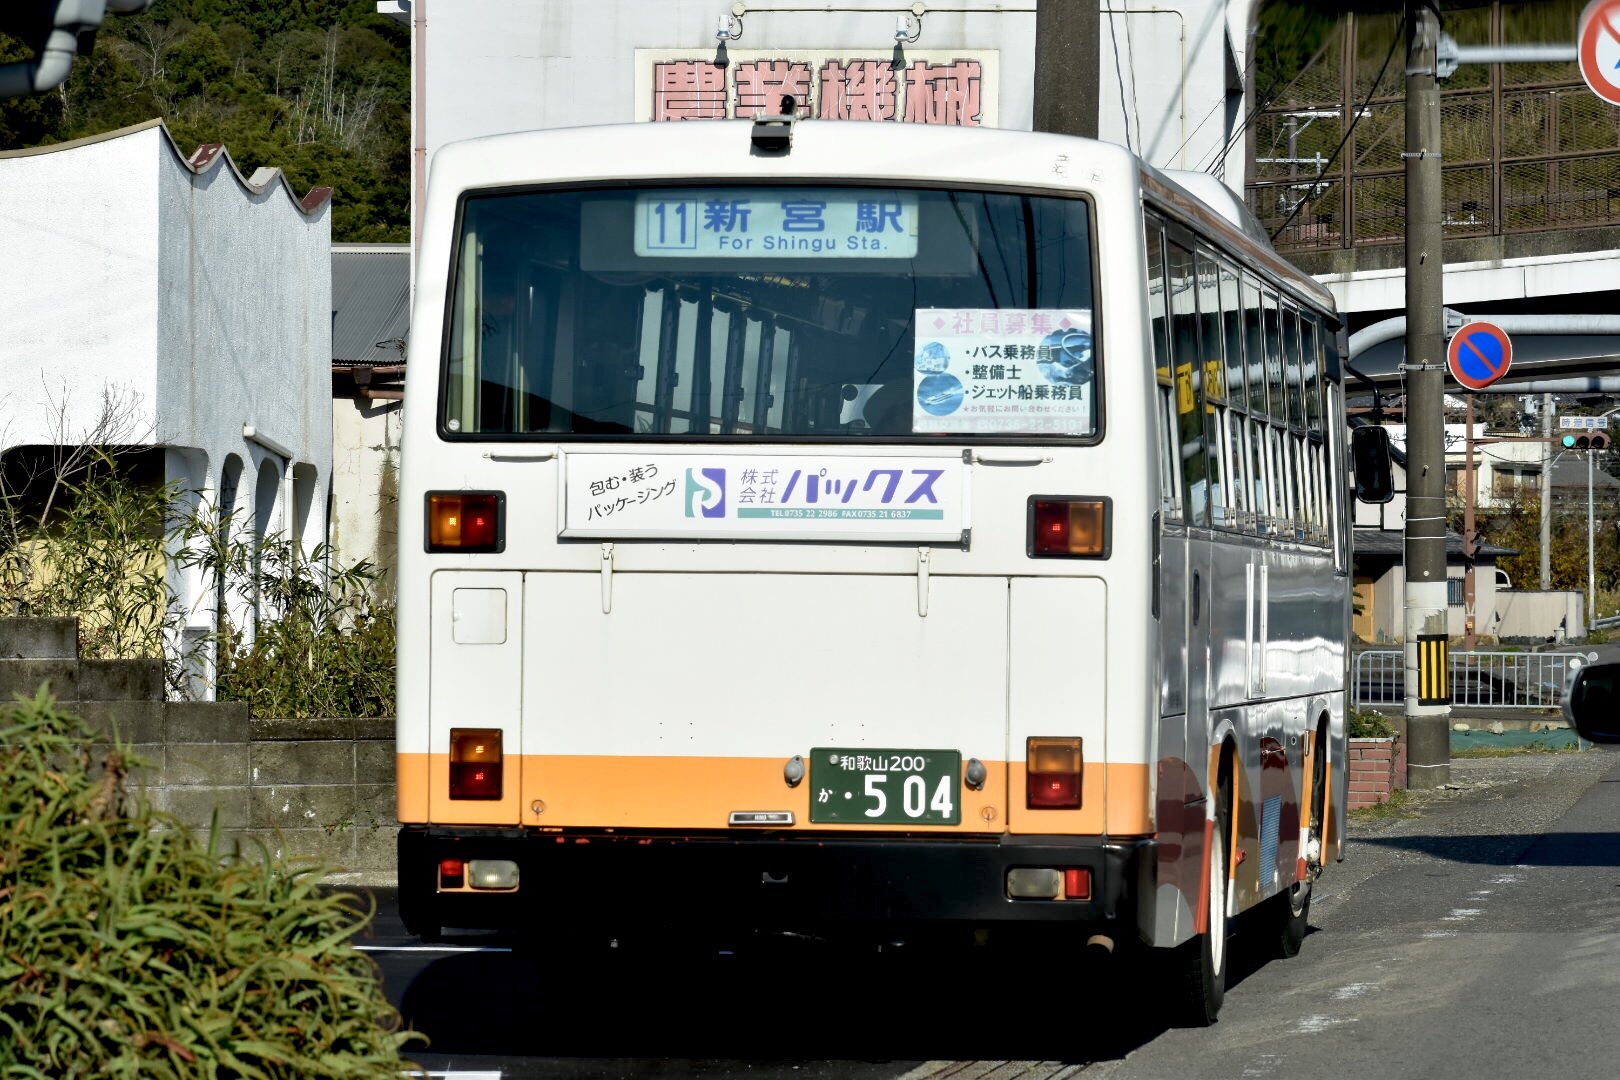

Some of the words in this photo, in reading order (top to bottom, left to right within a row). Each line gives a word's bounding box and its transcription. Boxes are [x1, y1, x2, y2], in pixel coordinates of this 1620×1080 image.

[655, 201, 687, 244] 11
[704, 199, 904, 233] 新宮駅
[719, 236, 753, 250] For
[763, 235, 836, 252] Shingu
[847, 236, 888, 250] Sta.
[952, 312, 1052, 335] 社員募集
[589, 463, 658, 496] 包む・装う
[780, 468, 946, 504] パックス
[587, 479, 677, 521] パッケージング
[805, 510, 815, 518] 22
[818, 510, 838, 518] 2986
[891, 511, 911, 519] 6837
[818, 788, 833, 803] か
